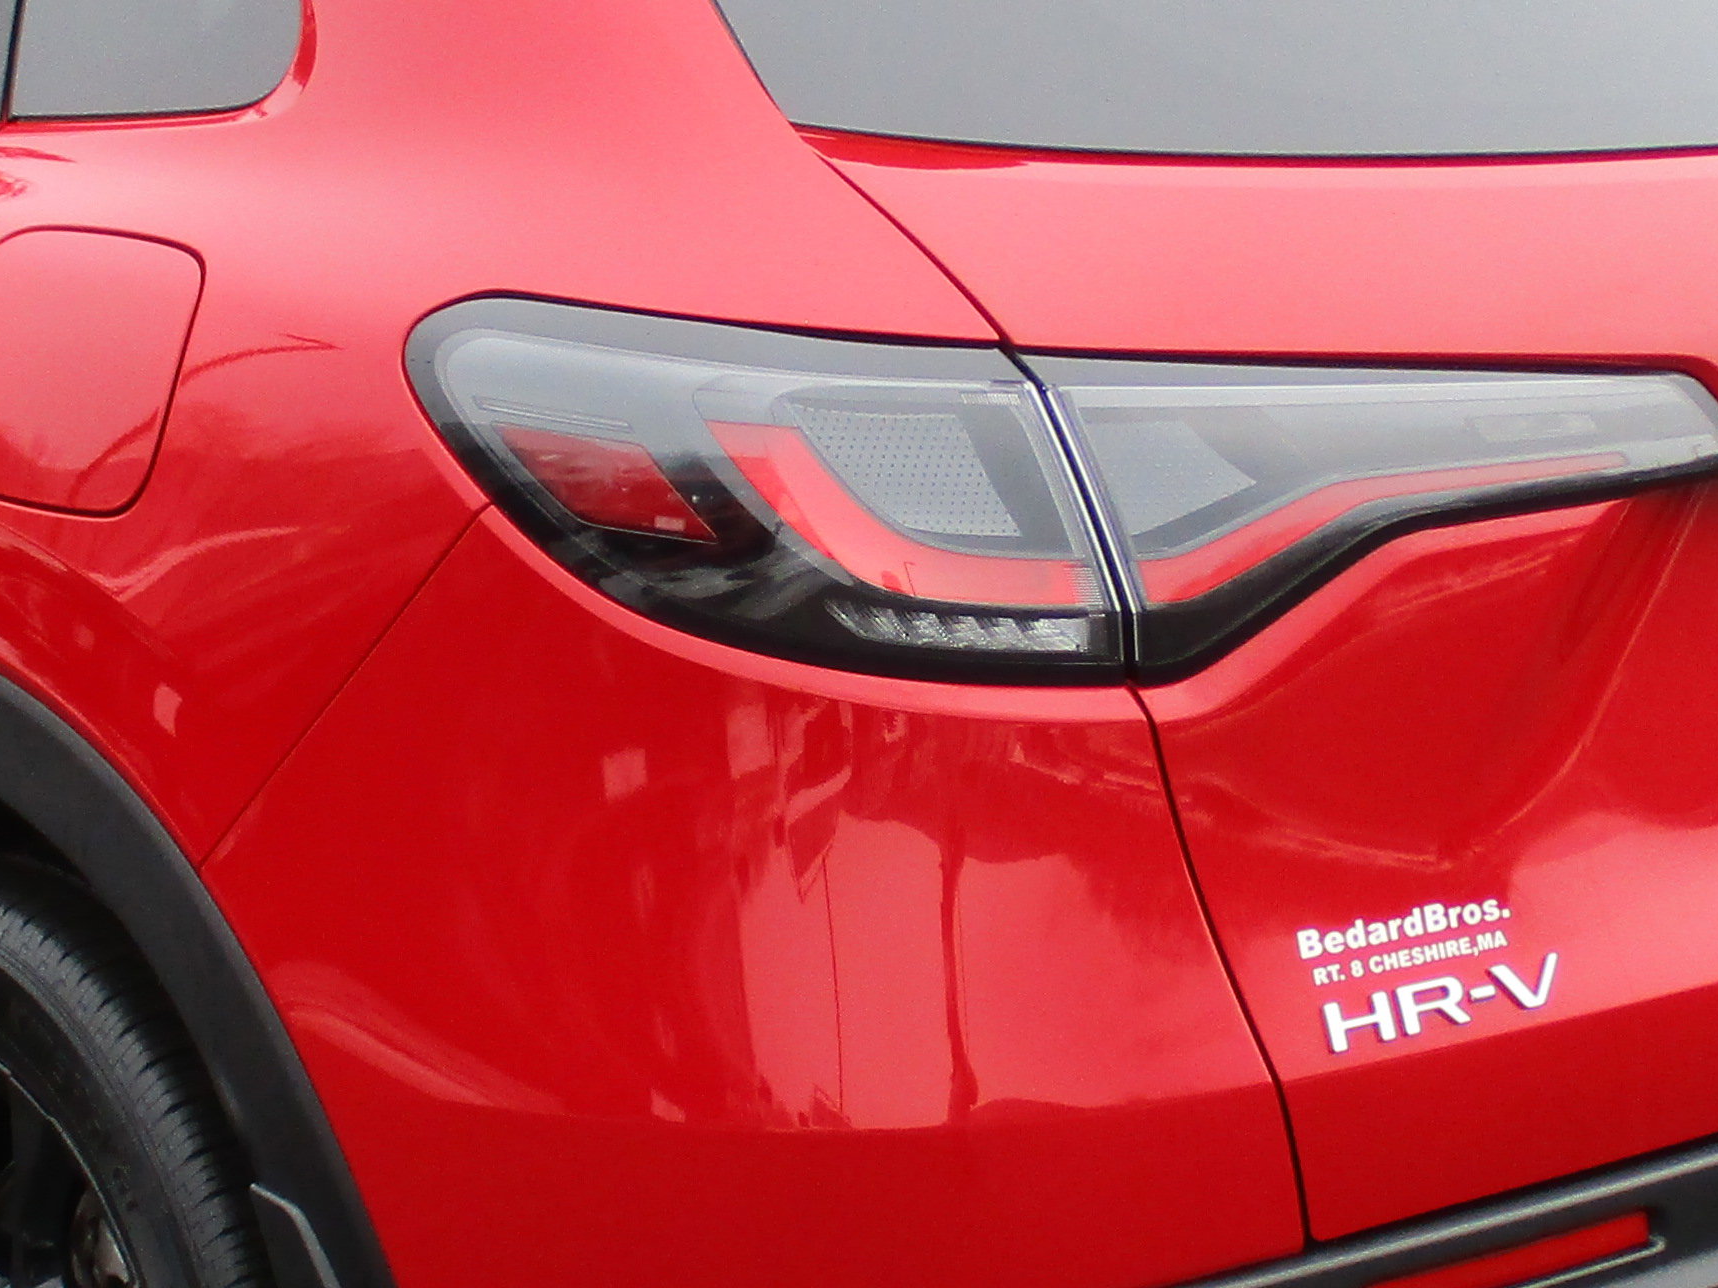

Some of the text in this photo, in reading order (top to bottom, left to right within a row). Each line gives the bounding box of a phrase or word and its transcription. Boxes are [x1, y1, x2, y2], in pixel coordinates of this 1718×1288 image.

[1312, 964, 1346, 986] RT.
[1350, 958, 1365, 978] 8
[1321, 951, 1559, 1054] HR-V
